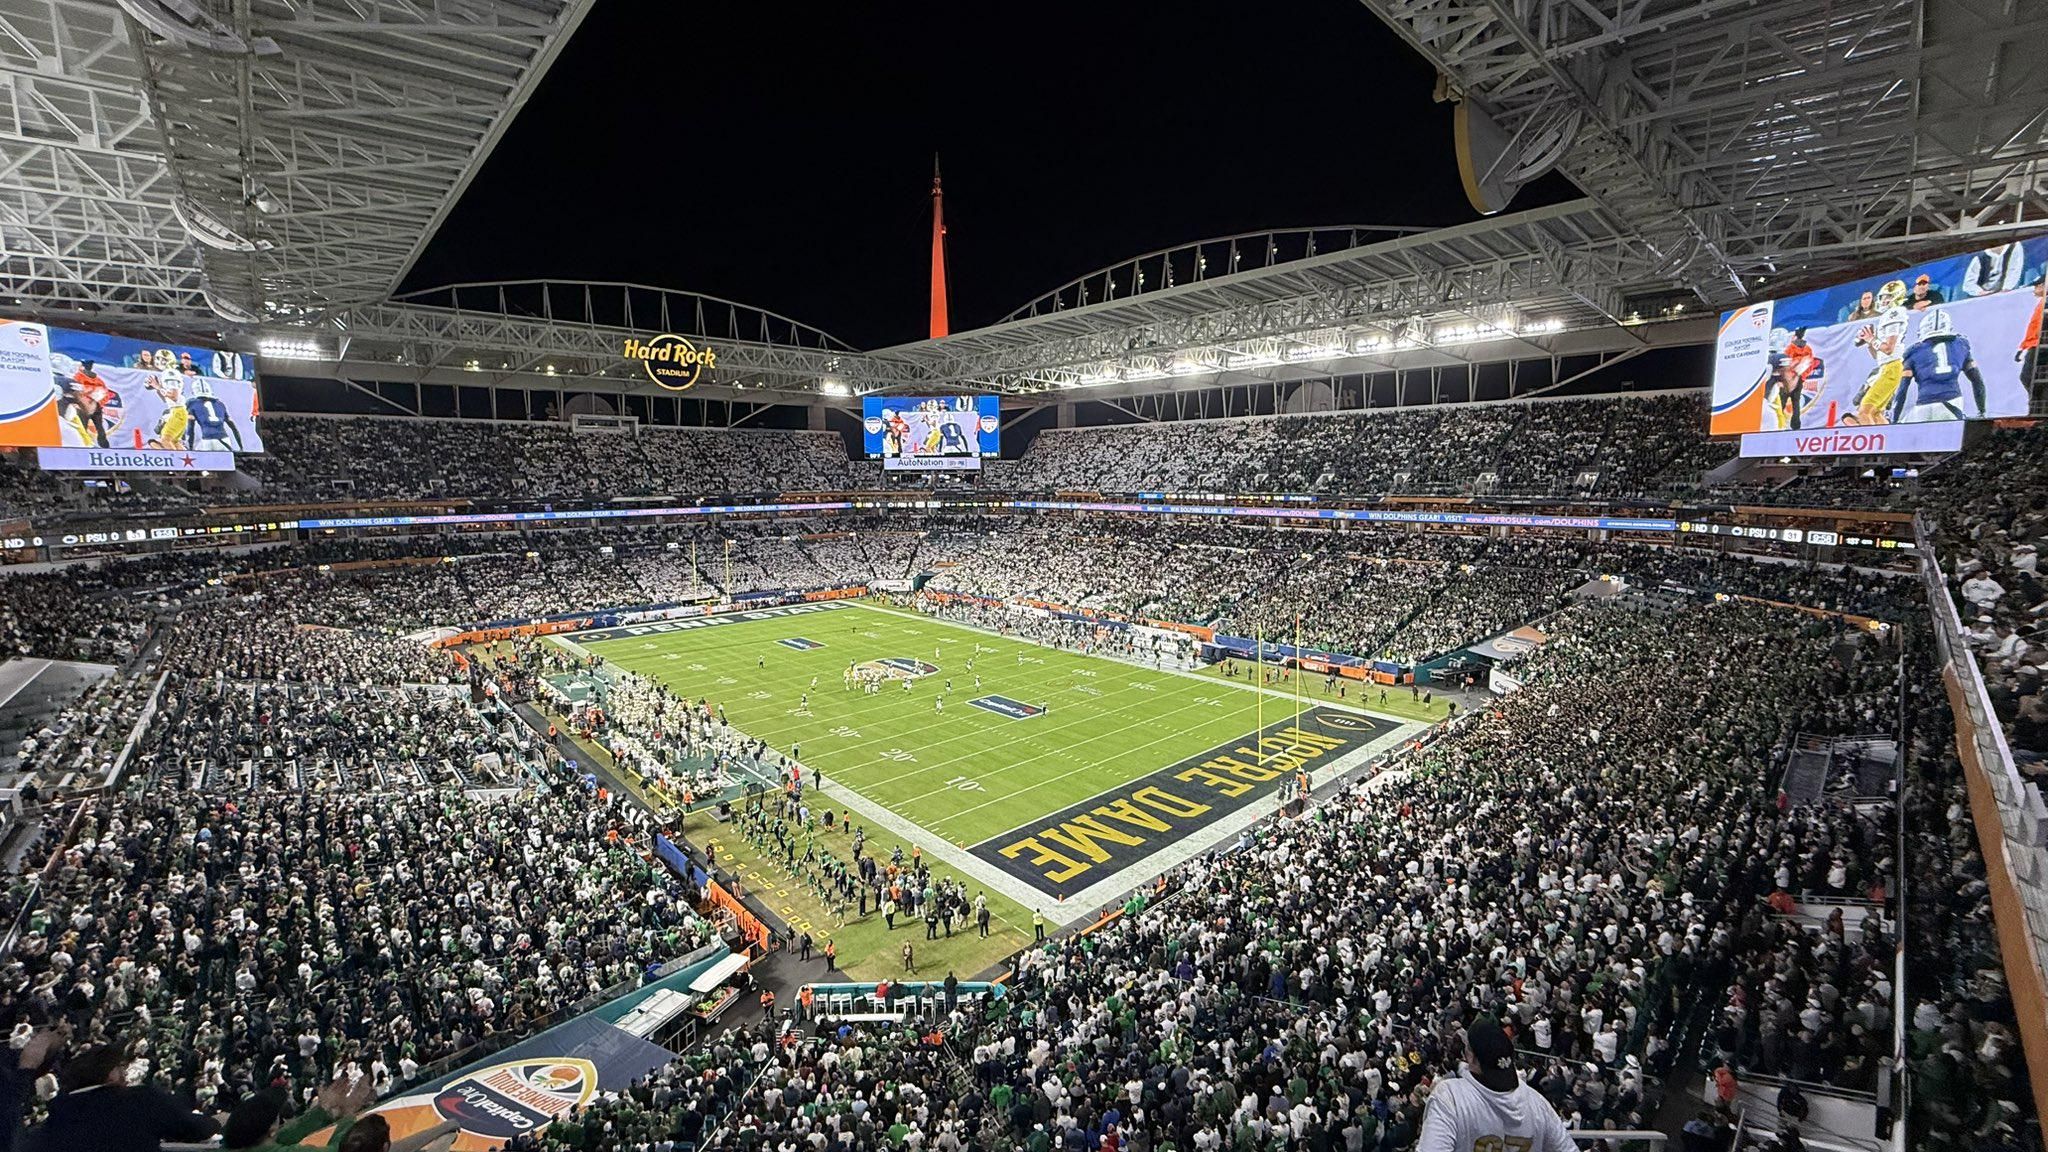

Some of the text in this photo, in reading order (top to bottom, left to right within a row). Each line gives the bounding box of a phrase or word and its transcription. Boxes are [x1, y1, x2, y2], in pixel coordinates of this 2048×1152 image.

[623, 338, 716, 369] Hard Rock
[1931, 342, 1952, 374] 1
[656, 368, 691, 378] STADIUM
[203, 402, 220, 422] 1
[1795, 430, 1886, 453] verizon
[90, 452, 175, 467] Heineken
[897, 457, 944, 467] AutoNation
[318, 519, 334, 527] WIN
[336, 518, 372, 526] DOLPHINS
[1368, 511, 1382, 519] WIN
[1383, 512, 1417, 521] DOLPHINS
[1418, 513, 1440, 521] GEAR!
[1712, 524, 1719, 534] 0
[1748, 527, 1767, 539] PSU
[1770, 529, 1777, 539] 0
[4, 536, 43, 549] ND 0
[85, 532, 107, 543] PSU
[111, 531, 119, 541] 0
[625, 601, 848, 636] PENN STATE
[879, 748, 912, 763] 20
[944, 776, 980, 791] 10
[997, 726, 1349, 884] NOTRE DAME
